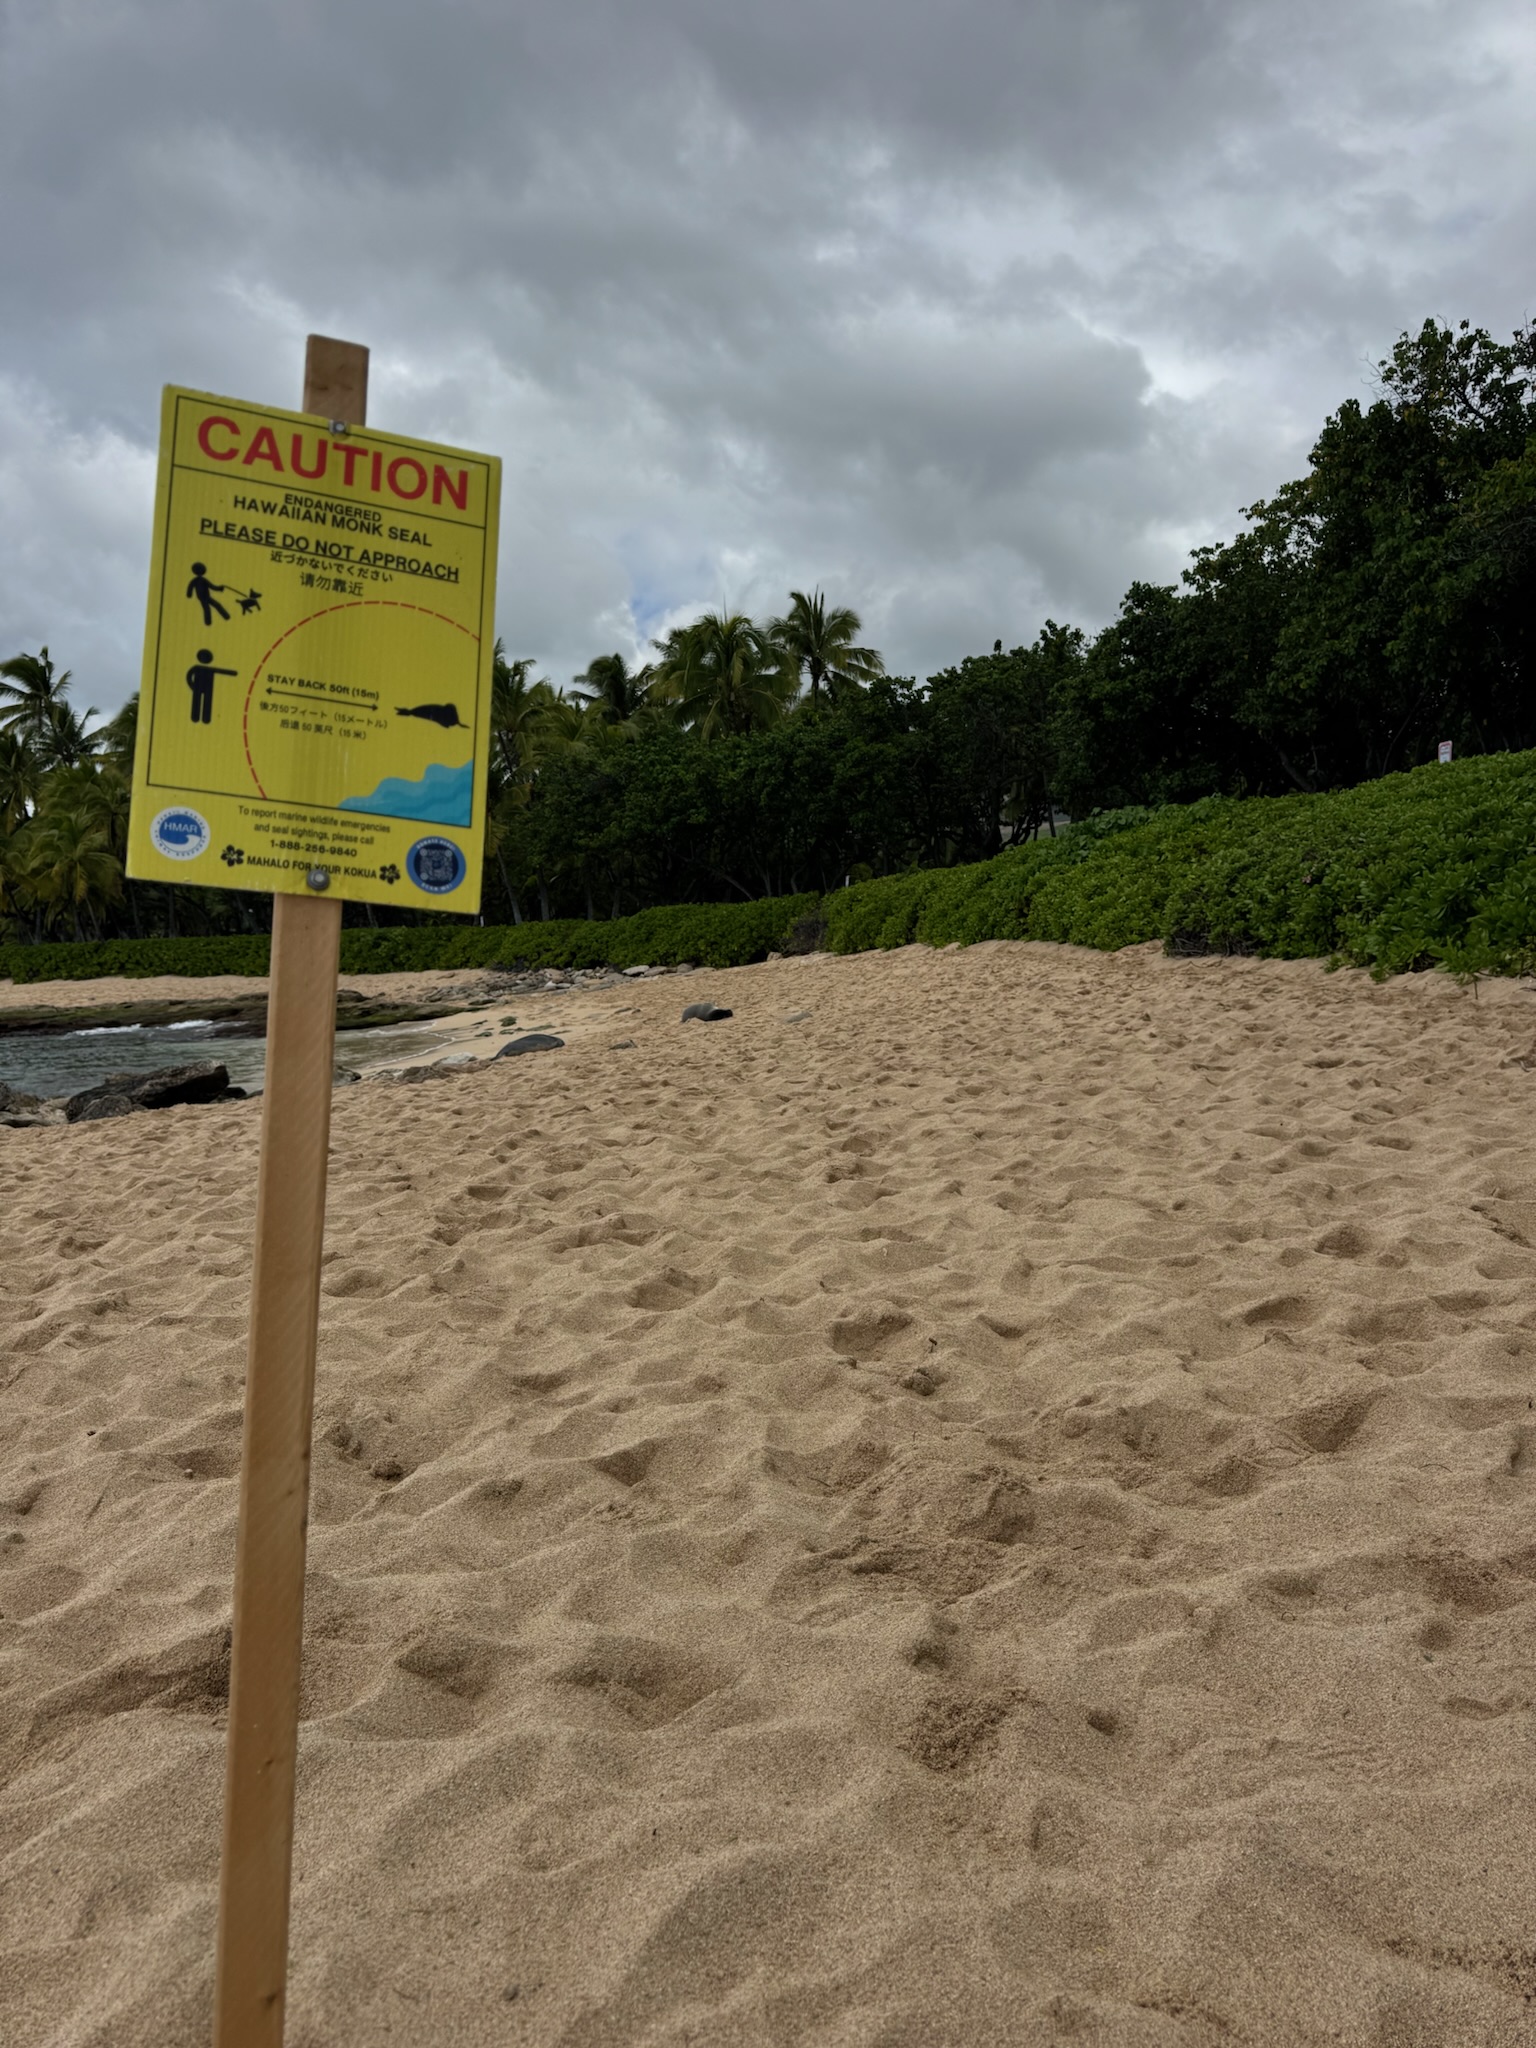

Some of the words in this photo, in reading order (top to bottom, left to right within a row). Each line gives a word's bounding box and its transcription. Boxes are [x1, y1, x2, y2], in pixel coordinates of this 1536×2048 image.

[197, 416, 468, 510] CAUTION
[233, 494, 327, 526] HAWAIIAN
[331, 514, 384, 538] MONK
[388, 526, 433, 548] SEAL
[284, 493, 382, 523] ENDANGERED
[200, 518, 277, 546] PLEASE
[282, 533, 309, 551] DO
[315, 539, 354, 560] NOT
[359, 549, 459, 581] APPROACH
[267, 674, 296, 686] STAY
[298, 678, 327, 691] BACK
[329, 684, 350, 696] 50ft
[351, 687, 380, 702] (15m)
[163, 821, 198, 834] HMAR
[238, 805, 250, 815] To
[251, 808, 277, 819] report
[278, 811, 308, 822] marine
[309, 814, 339, 826] wildlife
[340, 819, 391, 834] emergencies
[254, 823, 270, 832] and
[272, 826, 289, 835] seal
[331, 832, 359, 844] please
[360, 836, 375, 845] call
[246, 855, 290, 870] MAHALO
[292, 860, 312, 872] FOR
[343, 865, 377, 879] KOKUA
